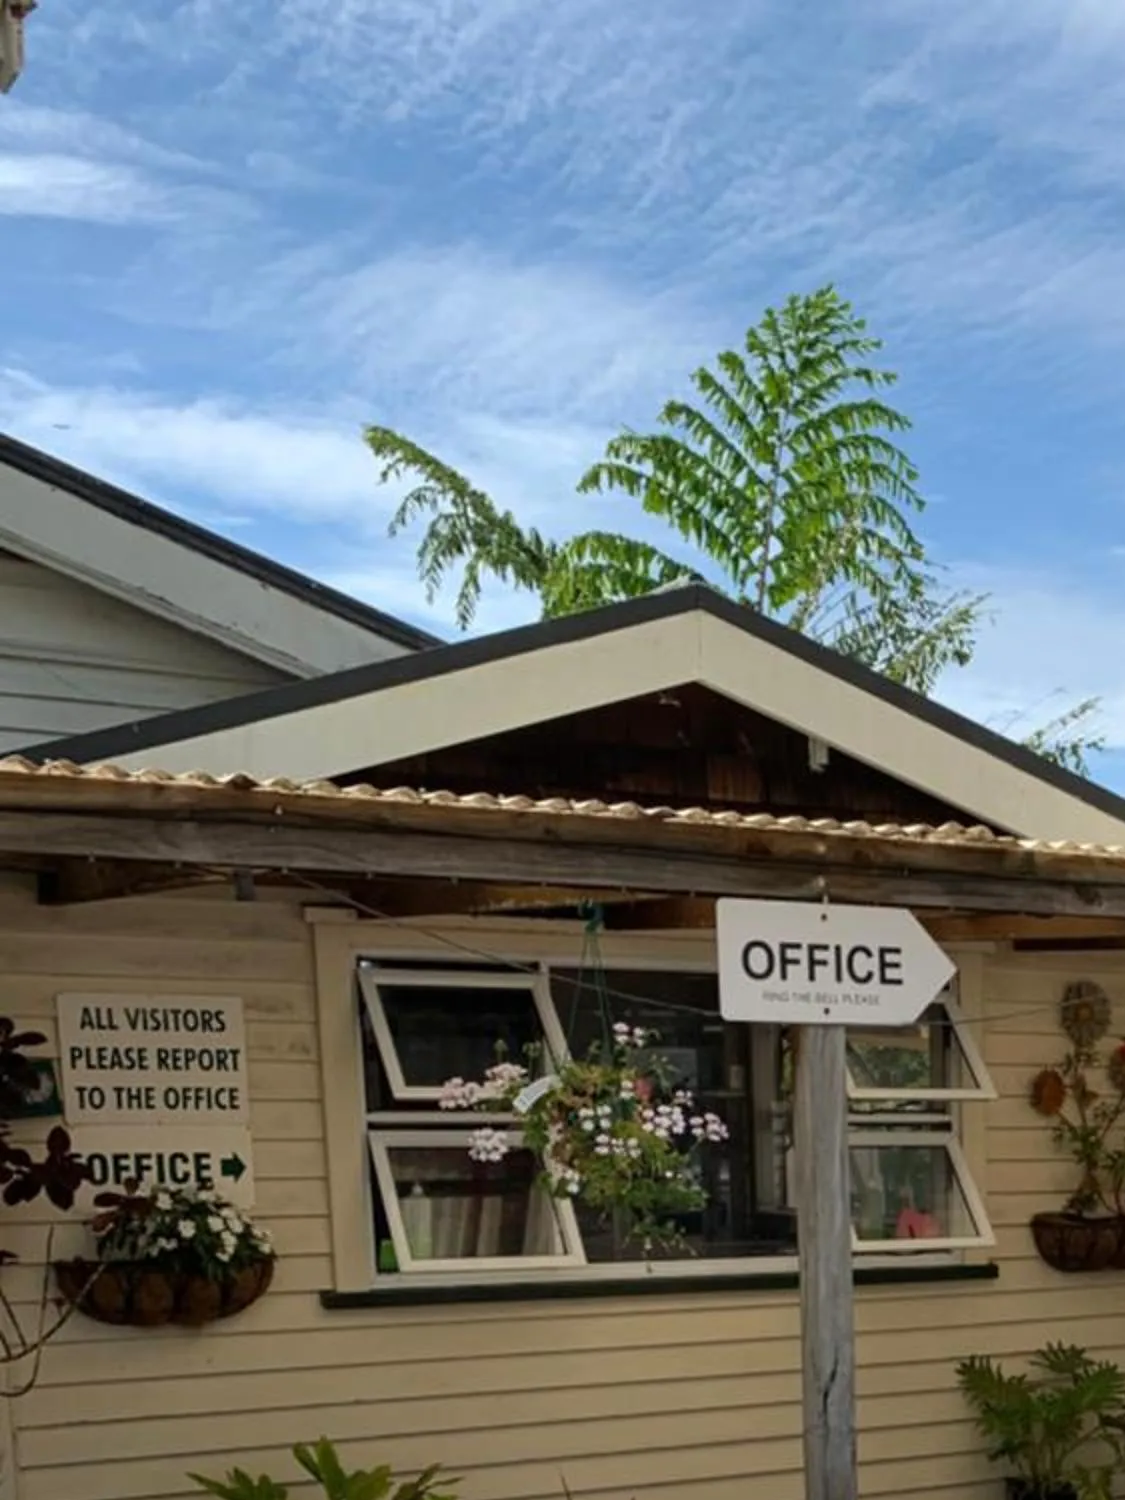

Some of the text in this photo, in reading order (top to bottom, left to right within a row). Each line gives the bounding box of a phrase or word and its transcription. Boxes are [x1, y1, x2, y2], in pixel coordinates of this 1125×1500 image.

[741, 940, 904, 986] OFFICE
[793, 991, 812, 1004] THE
[80, 1007, 226, 1033] ALL VISITORS
[70, 1046, 242, 1073] PLEASE REPORT
[75, 1086, 241, 1111] TO THE OFFICE
[86, 1152, 212, 1186] OFFICE
